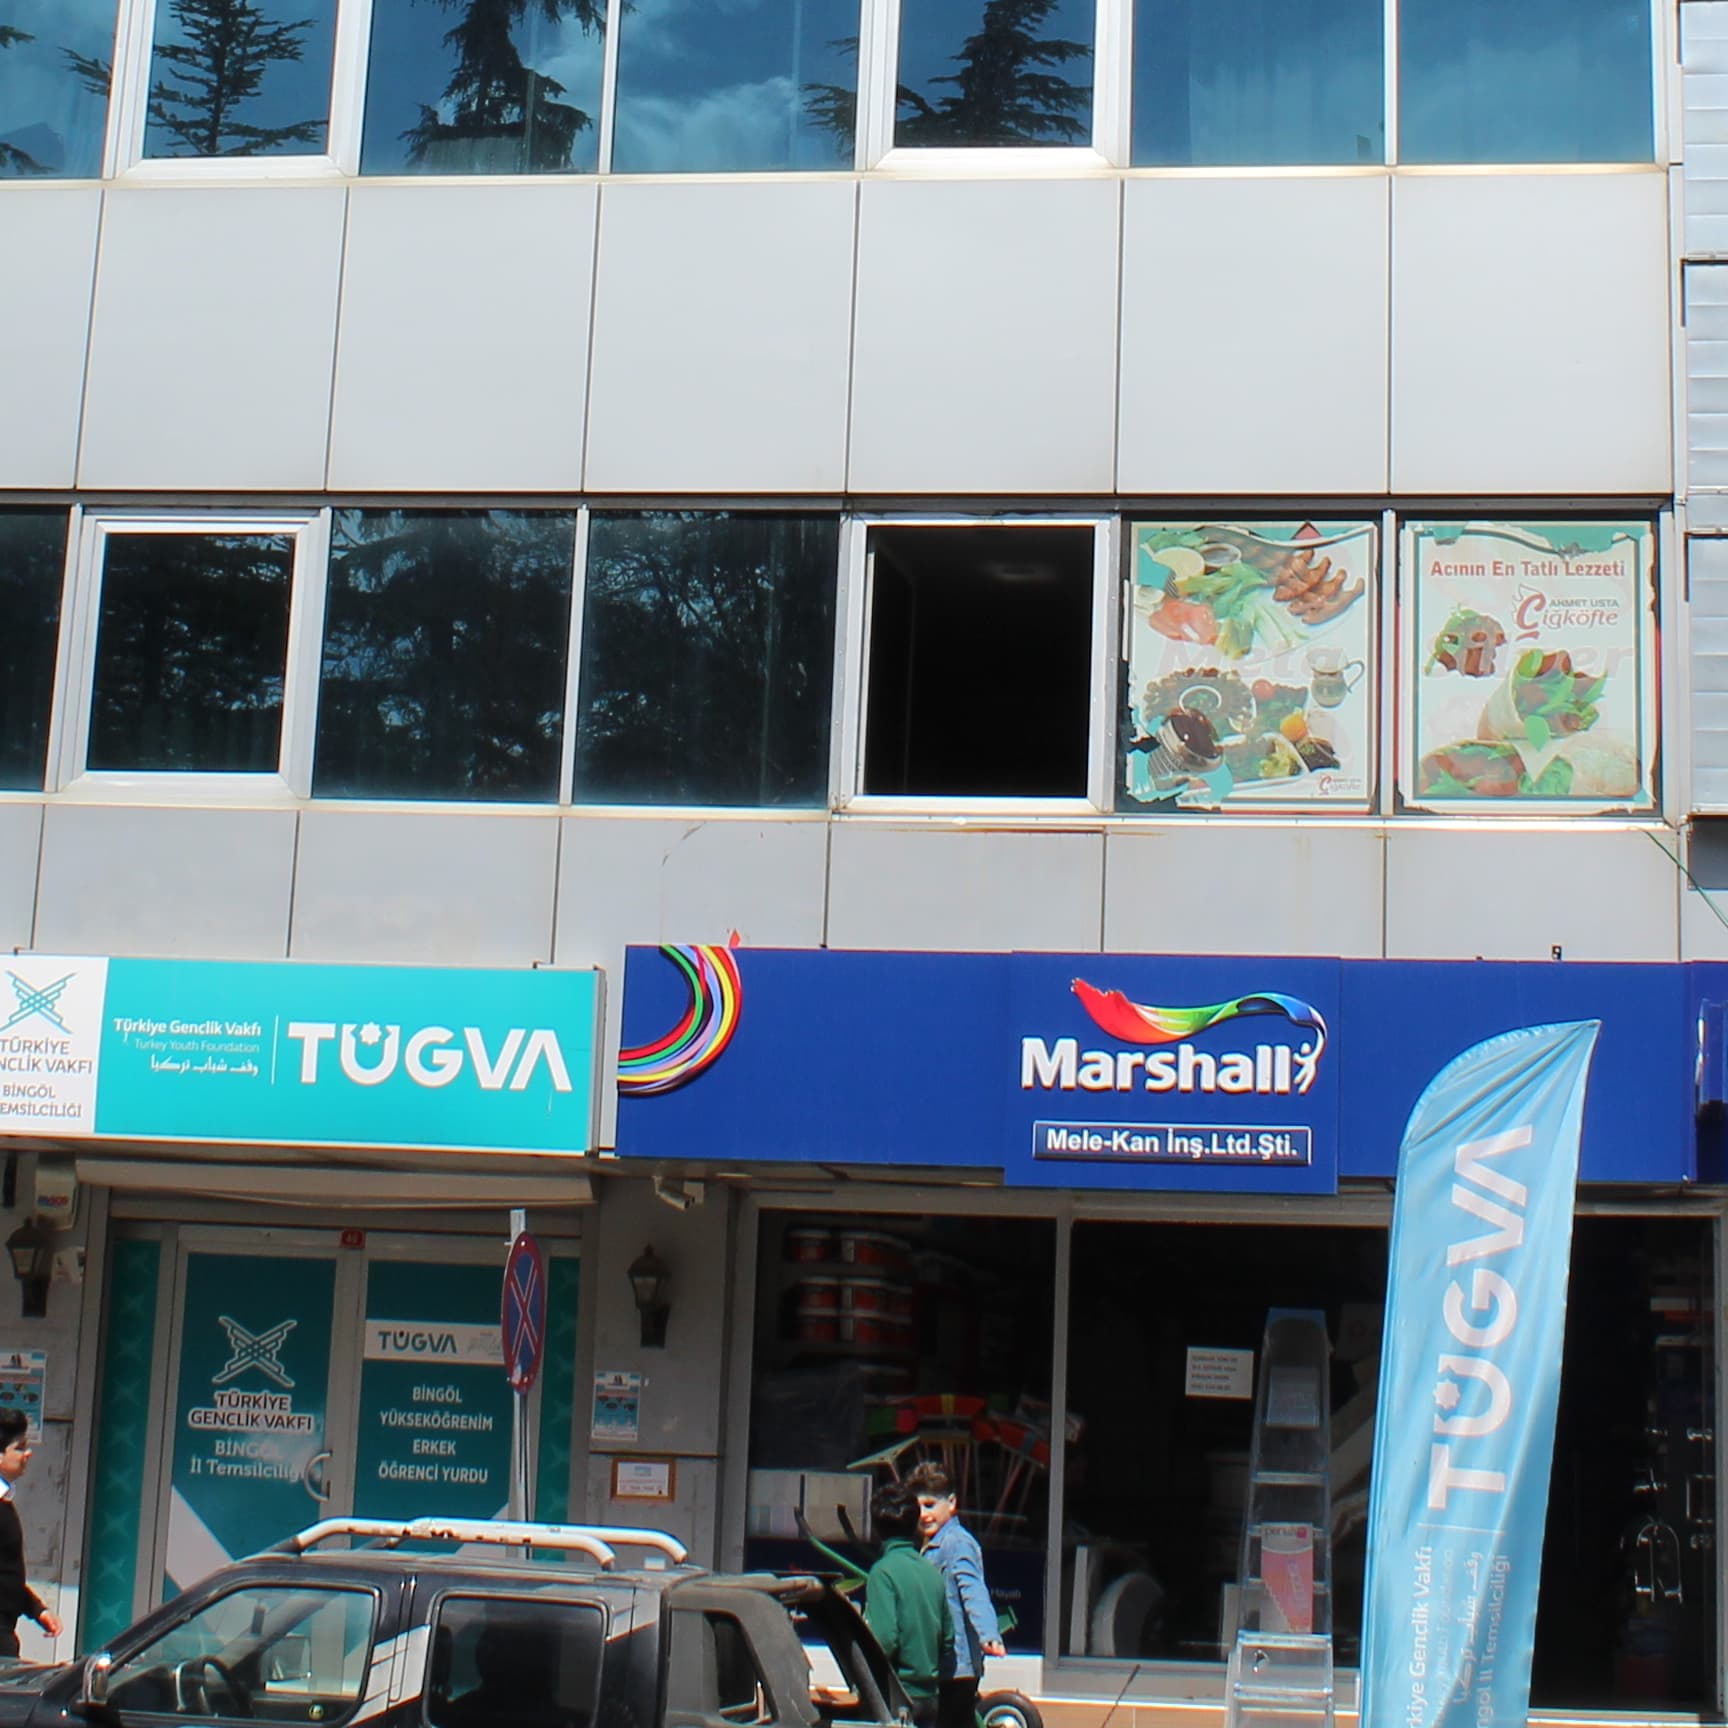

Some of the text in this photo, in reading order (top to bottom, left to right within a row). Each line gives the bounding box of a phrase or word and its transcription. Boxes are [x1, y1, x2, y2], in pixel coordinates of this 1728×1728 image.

[1430, 560, 1625, 577] Acının En Tatlı Lezzeti
[1549, 598, 1619, 608] AHMET USTA
[114, 1017, 262, 1036] Türkiye Genclik Vakfı
[135, 1038, 260, 1053] Turkey Youth Foundation
[45, 1057, 93, 1074] VAKFI
[287, 1021, 573, 1092] TÜGVA
[1022, 1036, 1291, 1094] Marshall
[2, 1083, 56, 1099] BİNGÖL
[1046, 1127, 1160, 1153] Mele-Kan
[1427, 1124, 1534, 1510] TÜGVA
[377, 1329, 458, 1354] TÜGVA
[216, 1390, 289, 1411] TÜRKİYE
[412, 1384, 463, 1404] BİNGÖL
[190, 1409, 312, 1430] GENCLİK VAKFI
[379, 1410, 493, 1431] YÜKSEKÖĞRENİM
[412, 1439, 456, 1456] ERKEK
[378, 1462, 489, 1484] ÖĞRENCİ YURDU
[1413, 1546, 1433, 1599] Vakfı
